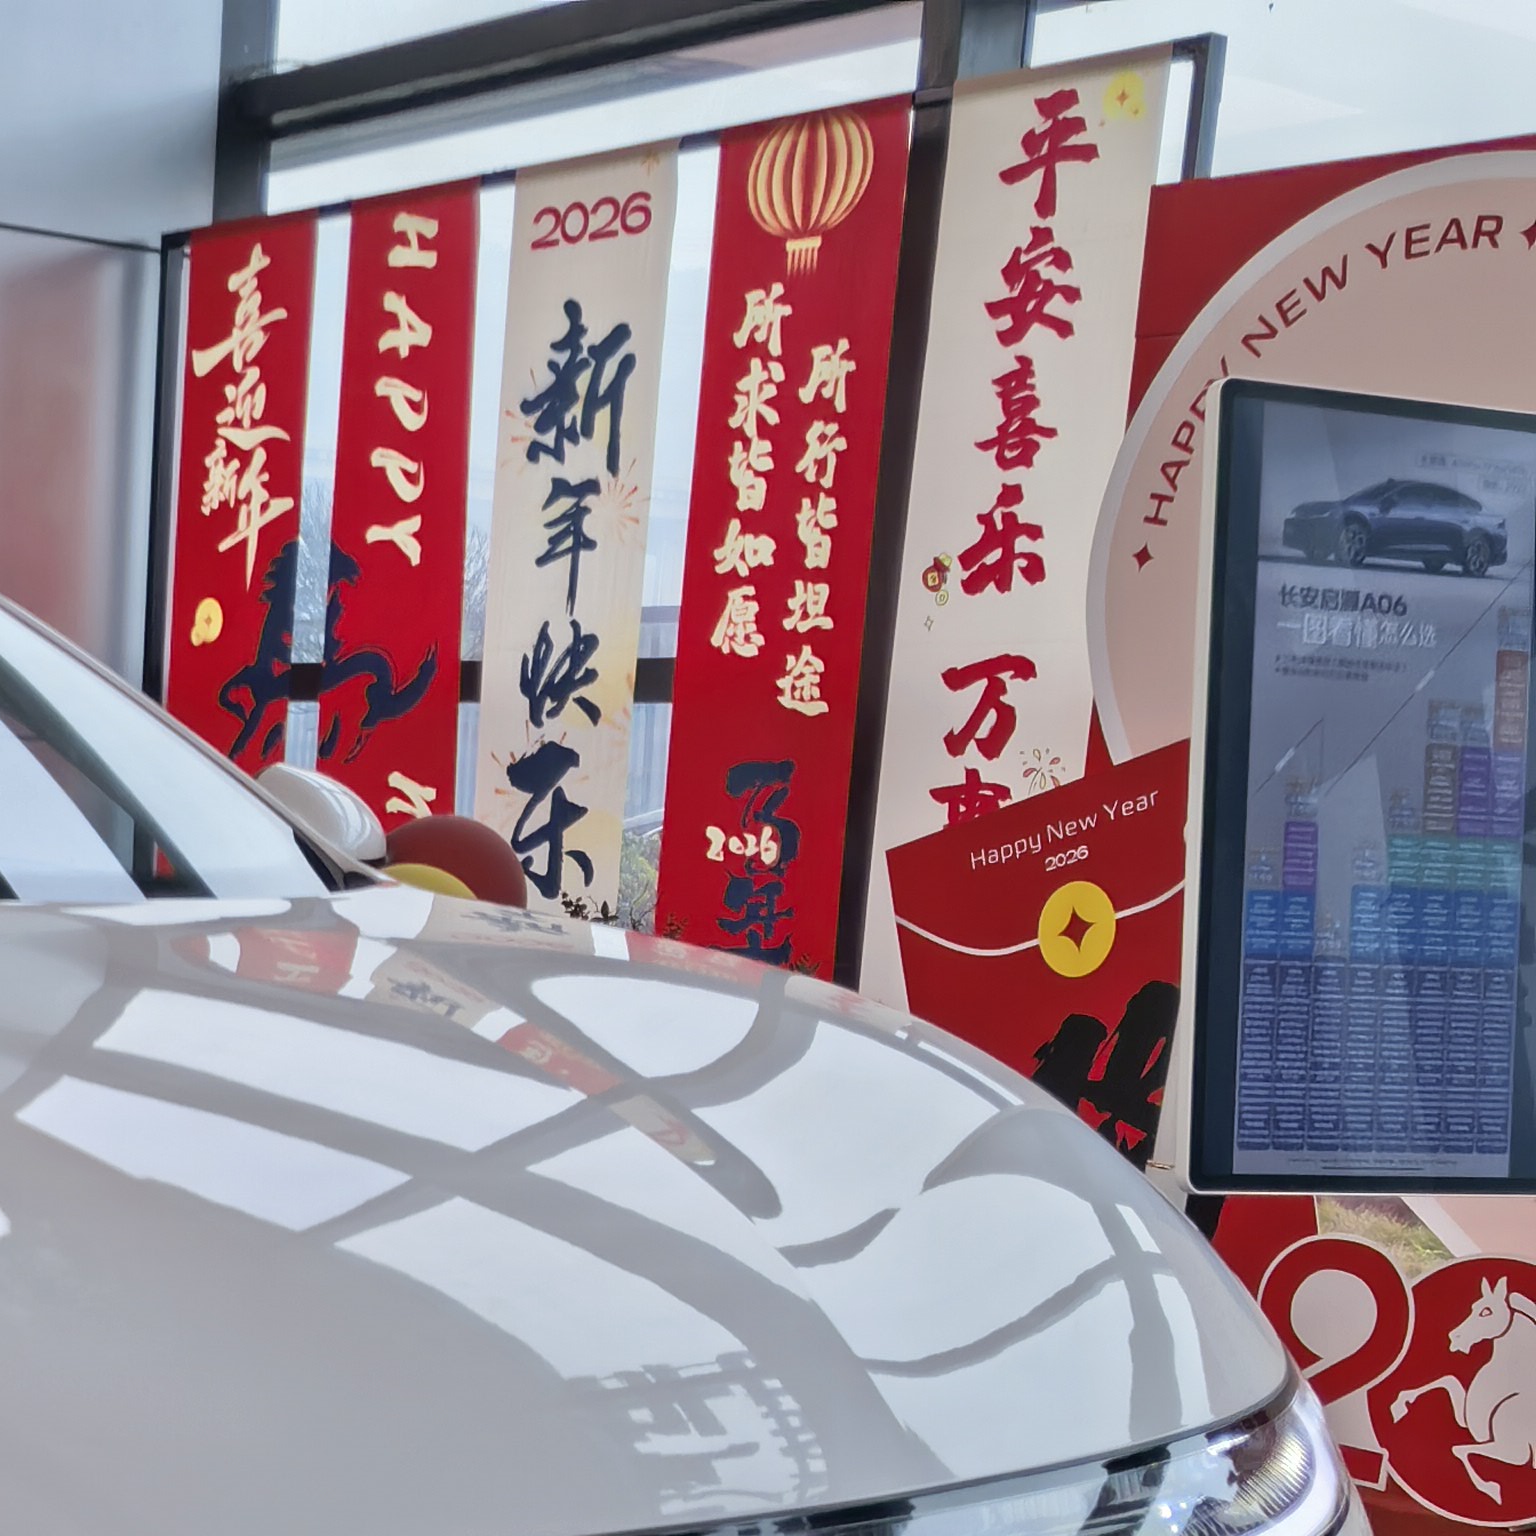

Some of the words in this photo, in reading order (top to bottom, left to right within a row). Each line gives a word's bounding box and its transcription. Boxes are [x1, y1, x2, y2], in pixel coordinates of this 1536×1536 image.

[530, 191, 652, 250] 2026
[1241, 254, 1349, 358] NEW
[1365, 214, 1505, 269] YEAR
[191, 241, 294, 587] 喜迎新年
[365, 212, 439, 567] HAPPY
[710, 282, 792, 657] 所求皆如愿
[506, 298, 636, 899] 新年快乐
[776, 337, 856, 717] 所行皆坦途
[705, 825, 778, 865] 2026
[970, 833, 1042, 870] Happy
[1046, 813, 1098, 843] New
[1102, 790, 1159, 821] Year
[1045, 845, 1089, 871] 2026
